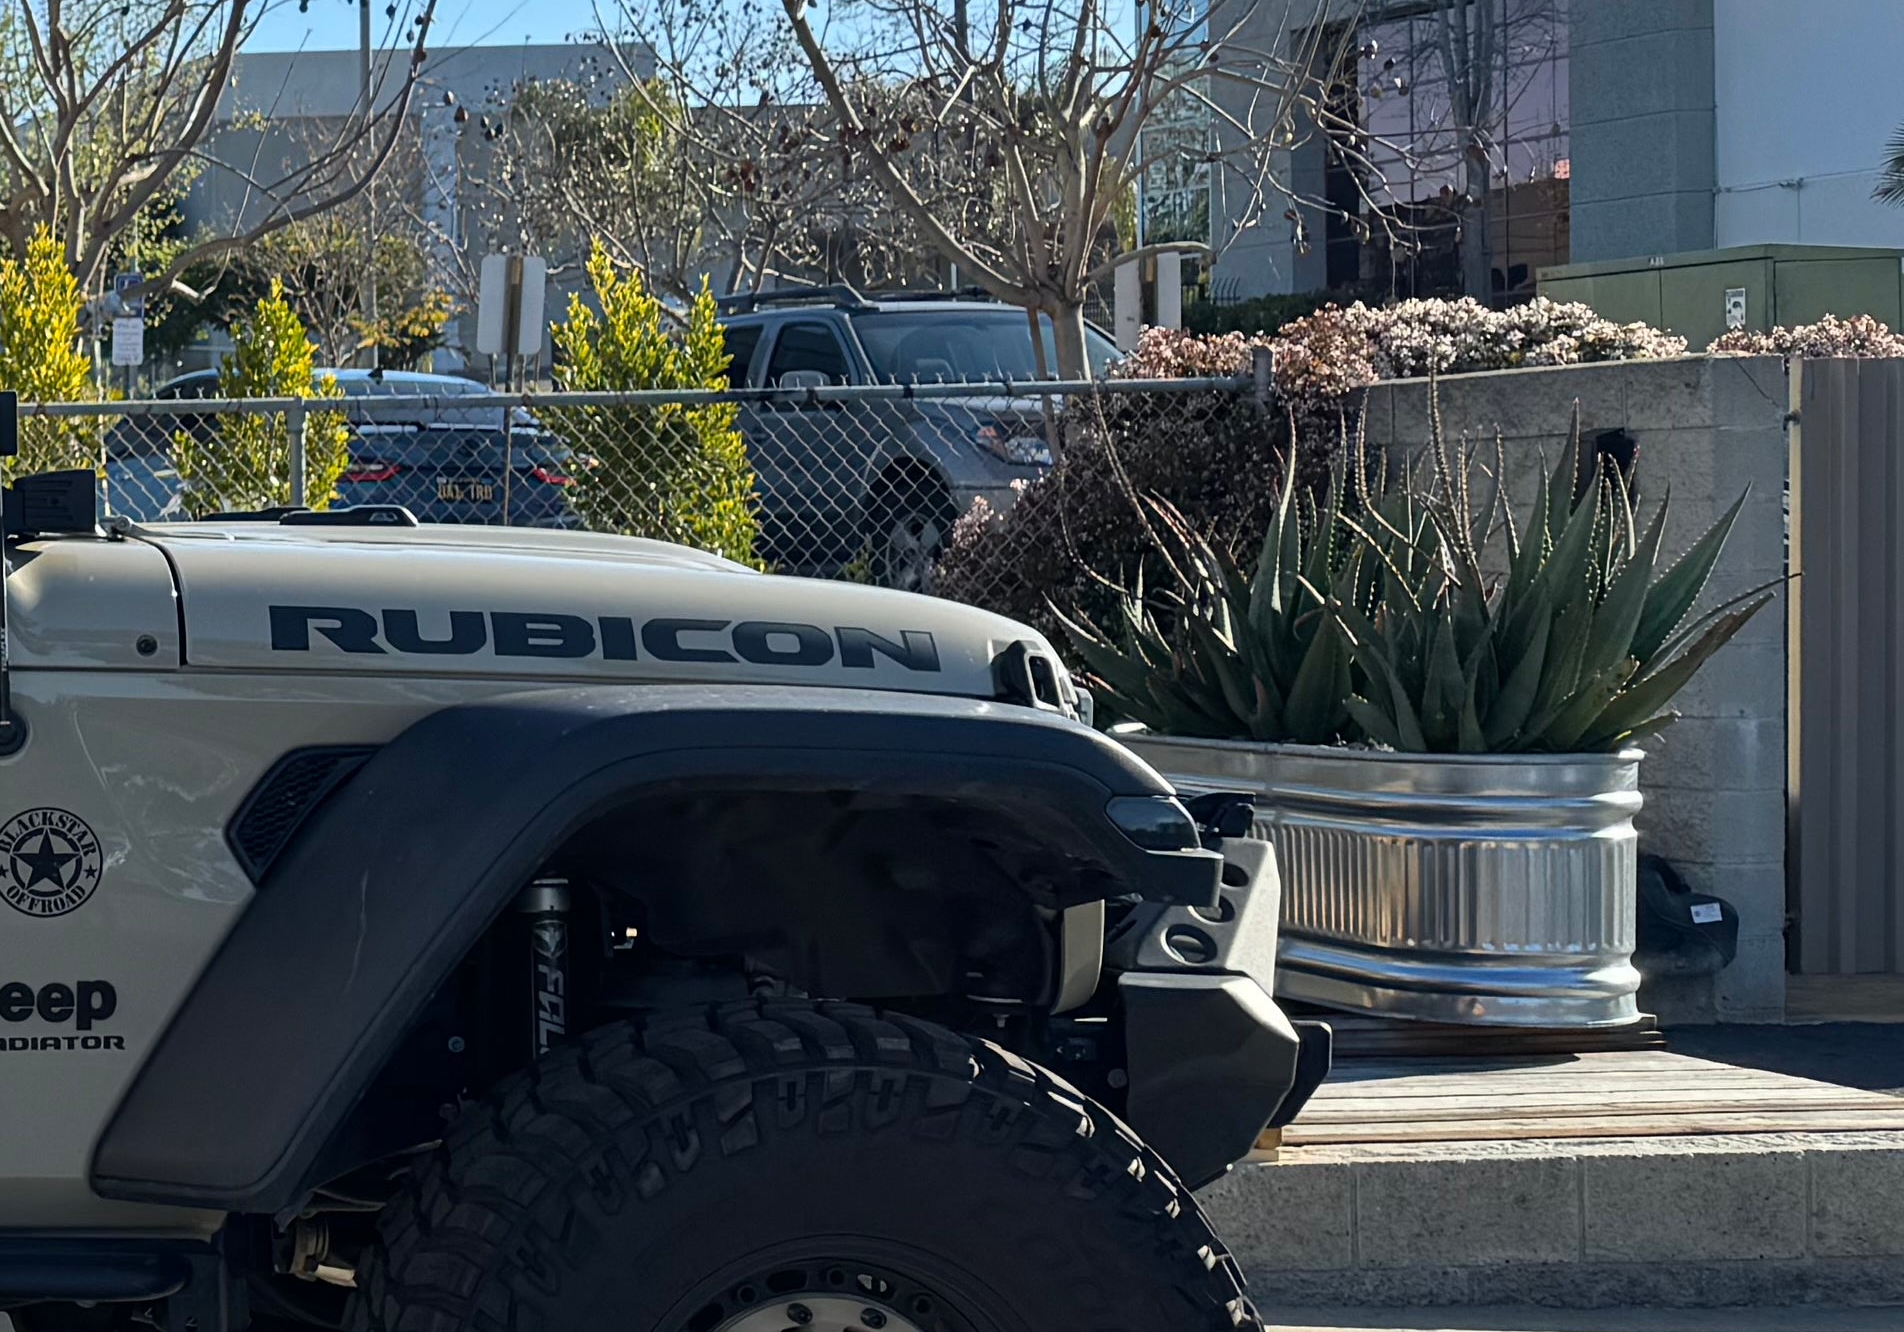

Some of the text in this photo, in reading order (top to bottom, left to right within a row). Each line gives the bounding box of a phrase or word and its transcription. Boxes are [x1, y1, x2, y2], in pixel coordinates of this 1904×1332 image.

[268, 605, 943, 673] RUBICON
[6, 885, 86, 913] OFFROAD
[537, 963, 567, 1055] FAL
